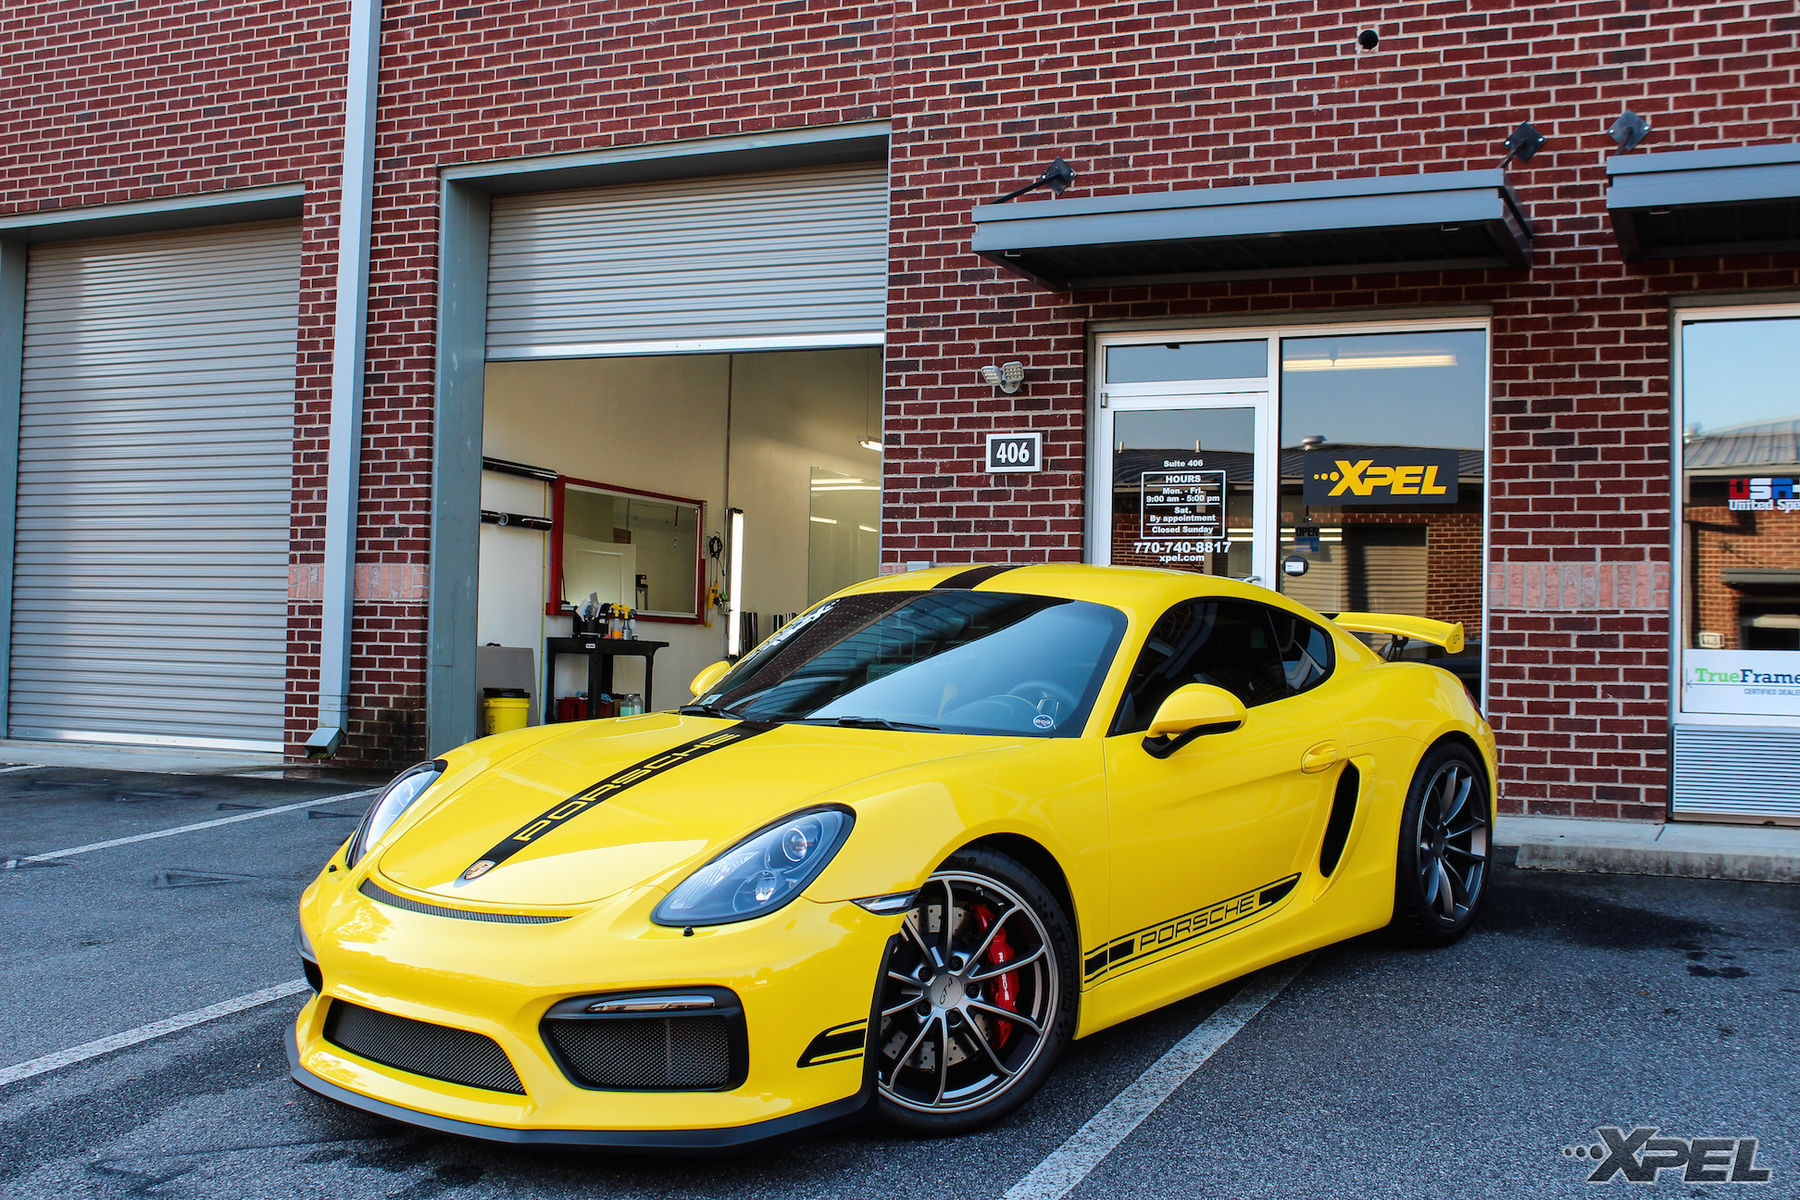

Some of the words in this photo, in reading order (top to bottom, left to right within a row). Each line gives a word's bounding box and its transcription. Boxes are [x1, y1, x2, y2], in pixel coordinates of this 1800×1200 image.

[996, 442, 1030, 464] 406
[1163, 460, 1186, 468] Suite
[1187, 459, 1203, 467] 406
[1165, 475, 1201, 483] HOURS
[1328, 460, 1447, 496] XPEL
[1162, 487, 1183, 495] Mon.
[1146, 495, 1164, 503] 9:00
[1728, 499, 1773, 511] United
[1150, 515, 1161, 523] By
[1163, 514, 1216, 523] appointment
[1152, 526, 1180, 534] Closed
[1182, 526, 1214, 534] Sunday
[1133, 541, 1232, 554] 770-740-8817
[1159, 554, 1205, 563] xpel.com
[512, 733, 742, 843] PORSCHE
[1139, 894, 1256, 951] PORSCHE
